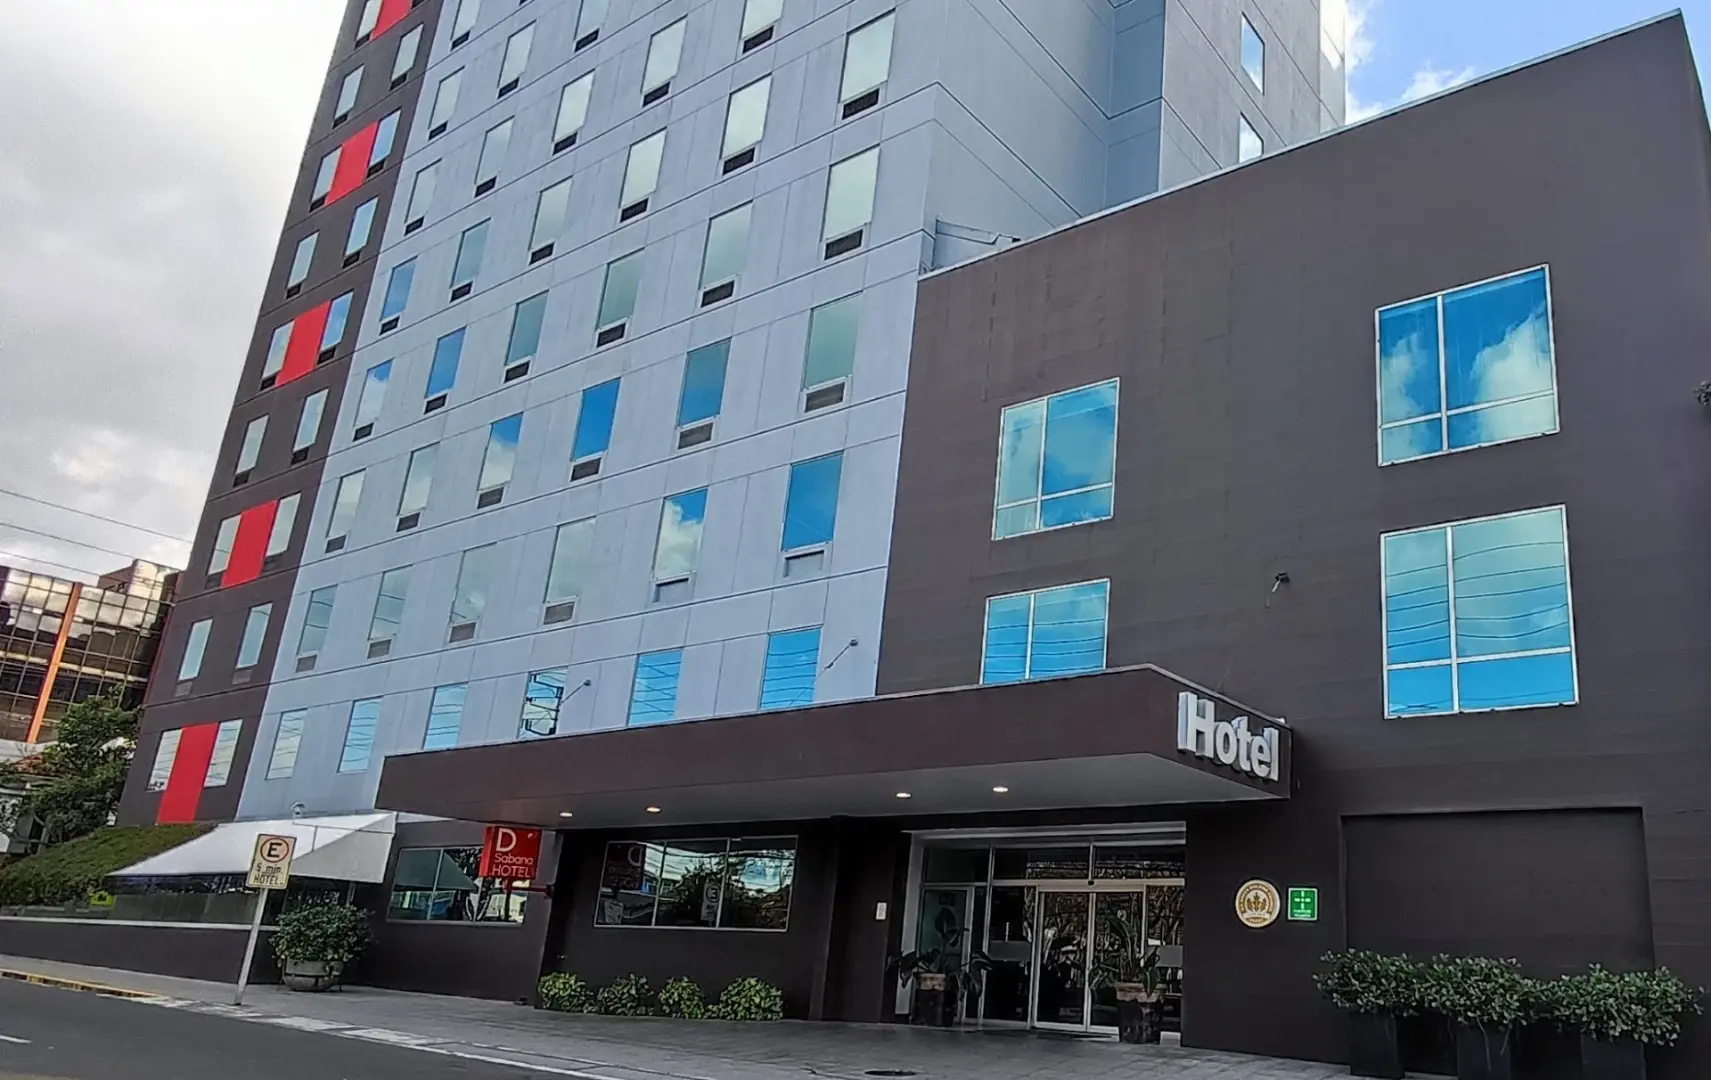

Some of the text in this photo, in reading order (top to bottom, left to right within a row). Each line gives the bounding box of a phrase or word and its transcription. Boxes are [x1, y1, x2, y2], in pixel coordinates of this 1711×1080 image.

[1177, 691, 1279, 782] Hotel
[266, 841, 283, 858] E
[494, 853, 534, 866] Sabana
[492, 864, 531, 878] HOTEL
